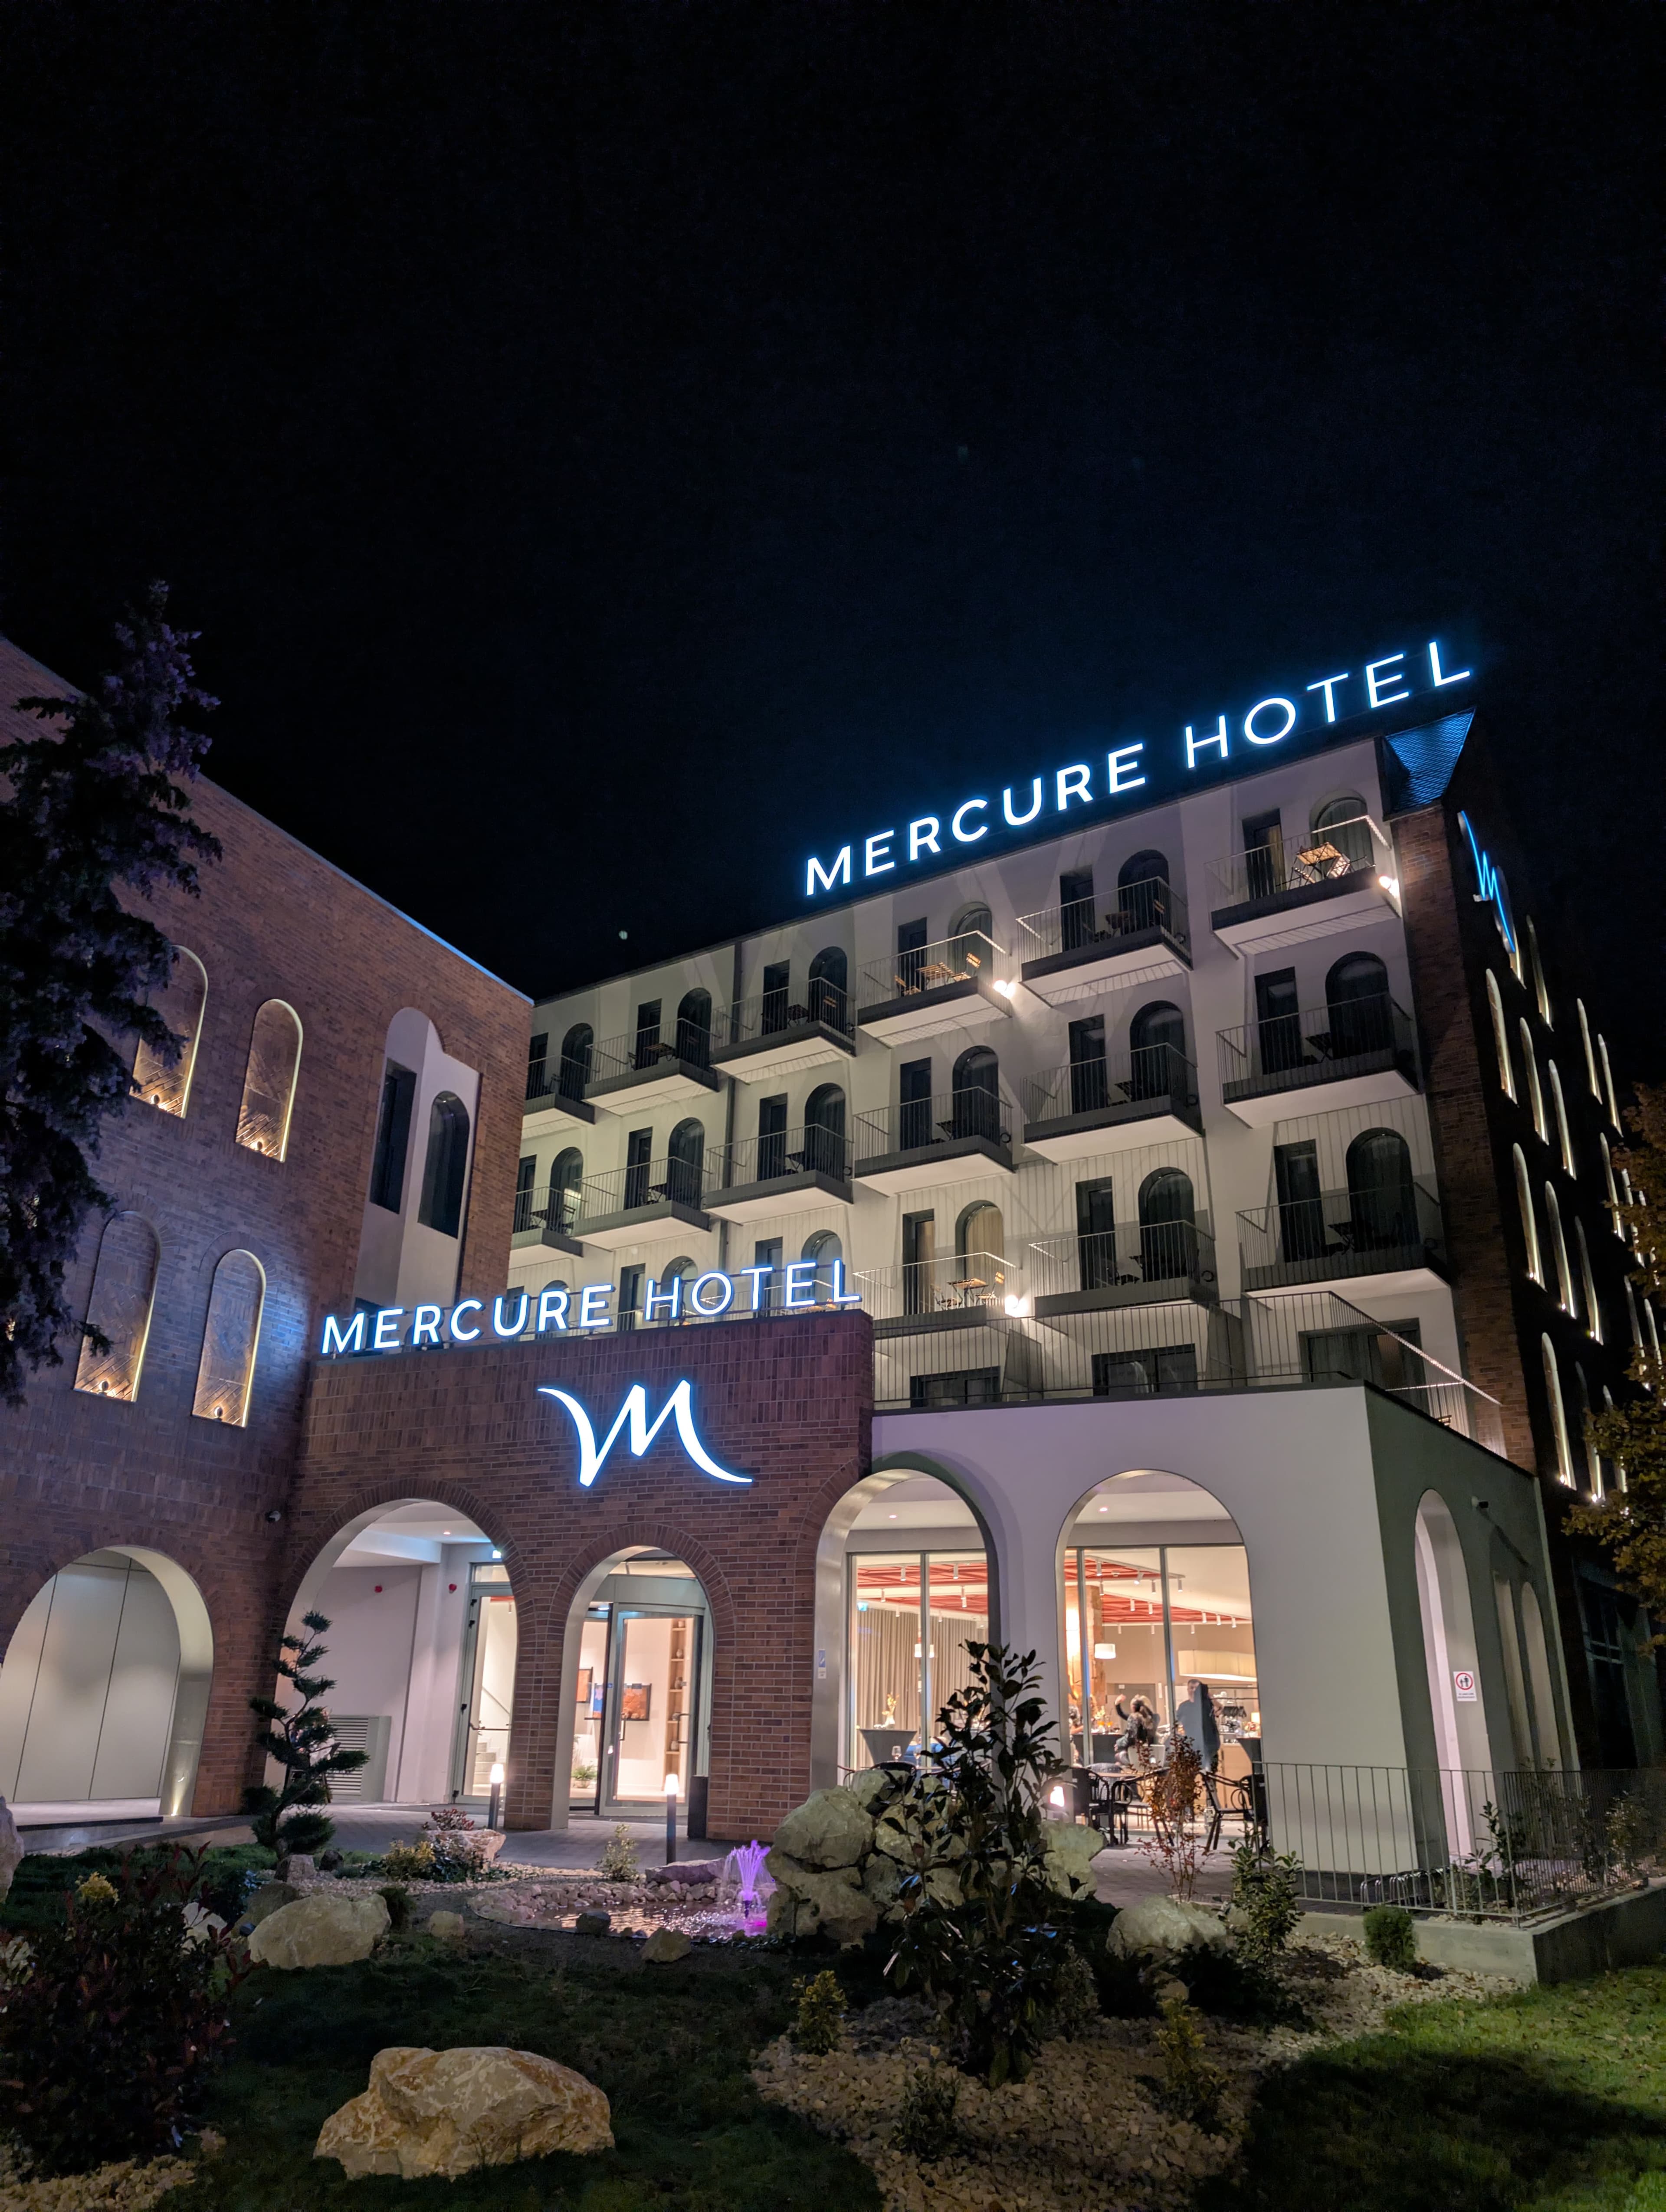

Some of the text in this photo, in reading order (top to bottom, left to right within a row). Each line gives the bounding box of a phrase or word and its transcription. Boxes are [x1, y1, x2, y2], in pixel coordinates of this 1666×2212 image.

[806, 641, 1471, 897] MERCURE HOTEL
[321, 1259, 861, 1354] MERCURE HOTEL
